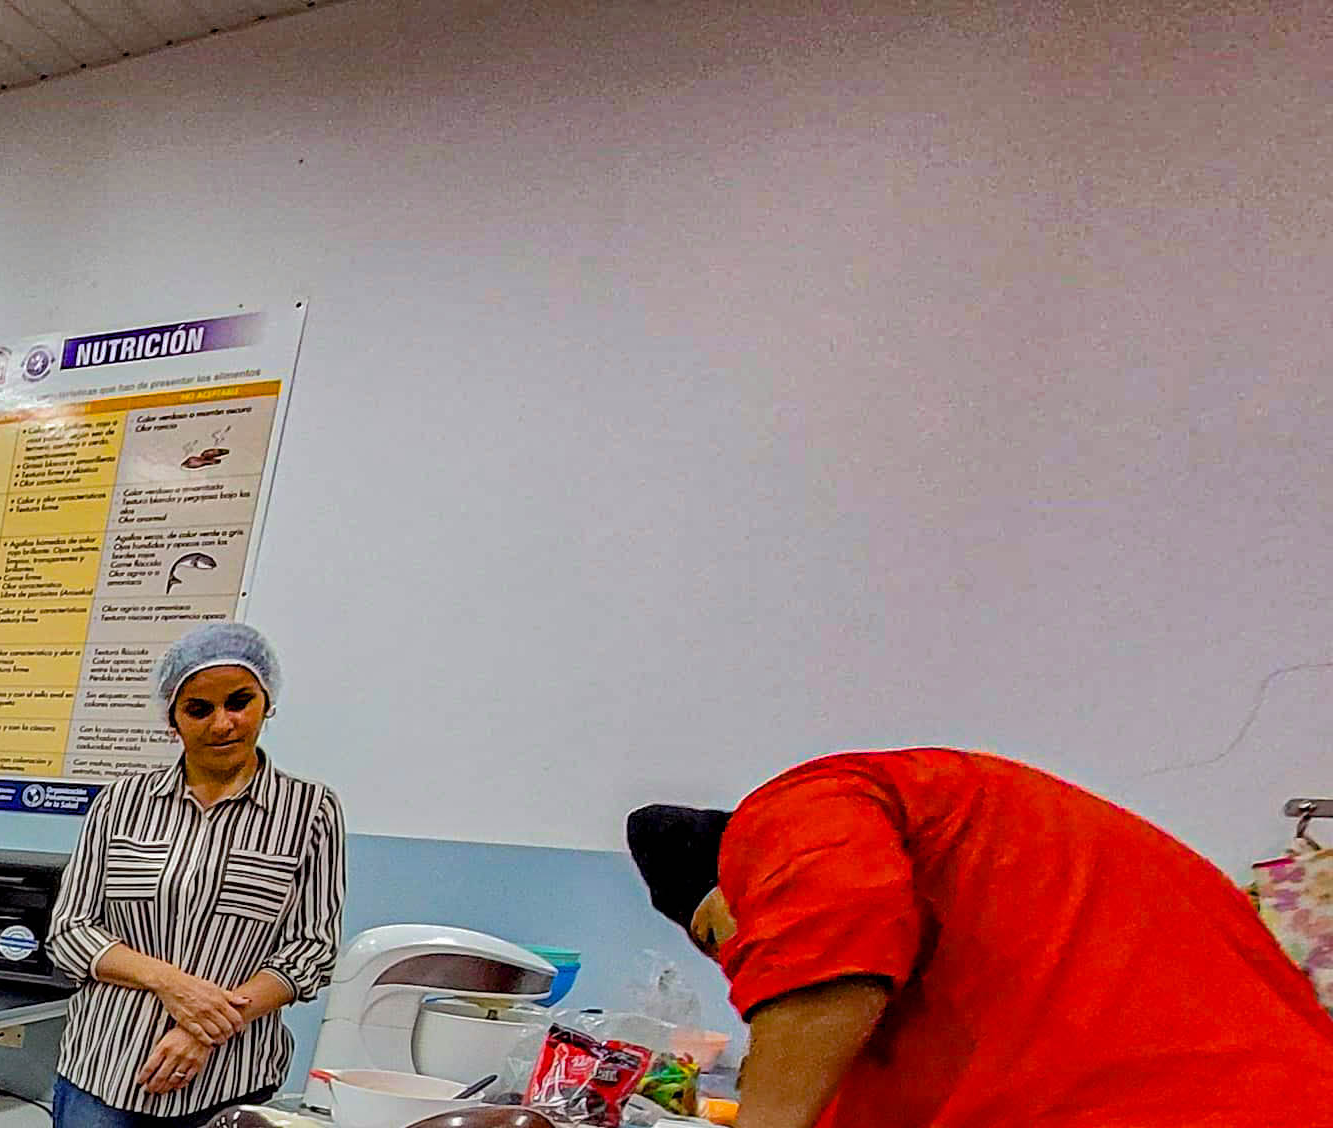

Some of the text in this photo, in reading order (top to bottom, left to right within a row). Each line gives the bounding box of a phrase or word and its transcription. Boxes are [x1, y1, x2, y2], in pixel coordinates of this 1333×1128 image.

[75, 324, 205, 367] NUTRICIÓN
[150, 368, 261, 391] presentar los alimentos
[137, 415, 157, 424] Color
[135, 424, 152, 433] Olor
[123, 489, 143, 497] Color
[219, 490, 238, 500] bajo
[16, 497, 35, 505] Color
[118, 514, 167, 524] Olor anormal
[166, 531, 177, 539] de
[179, 530, 198, 539] color
[199, 529, 220, 537] verde
[79, 536, 96, 544] color
[113, 543, 131, 551] Ojos
[132, 541, 165, 550] hundidos
[108, 570, 126, 578] Olor
[101, 604, 120, 613] Olor
[92, 657, 112, 666] Color
